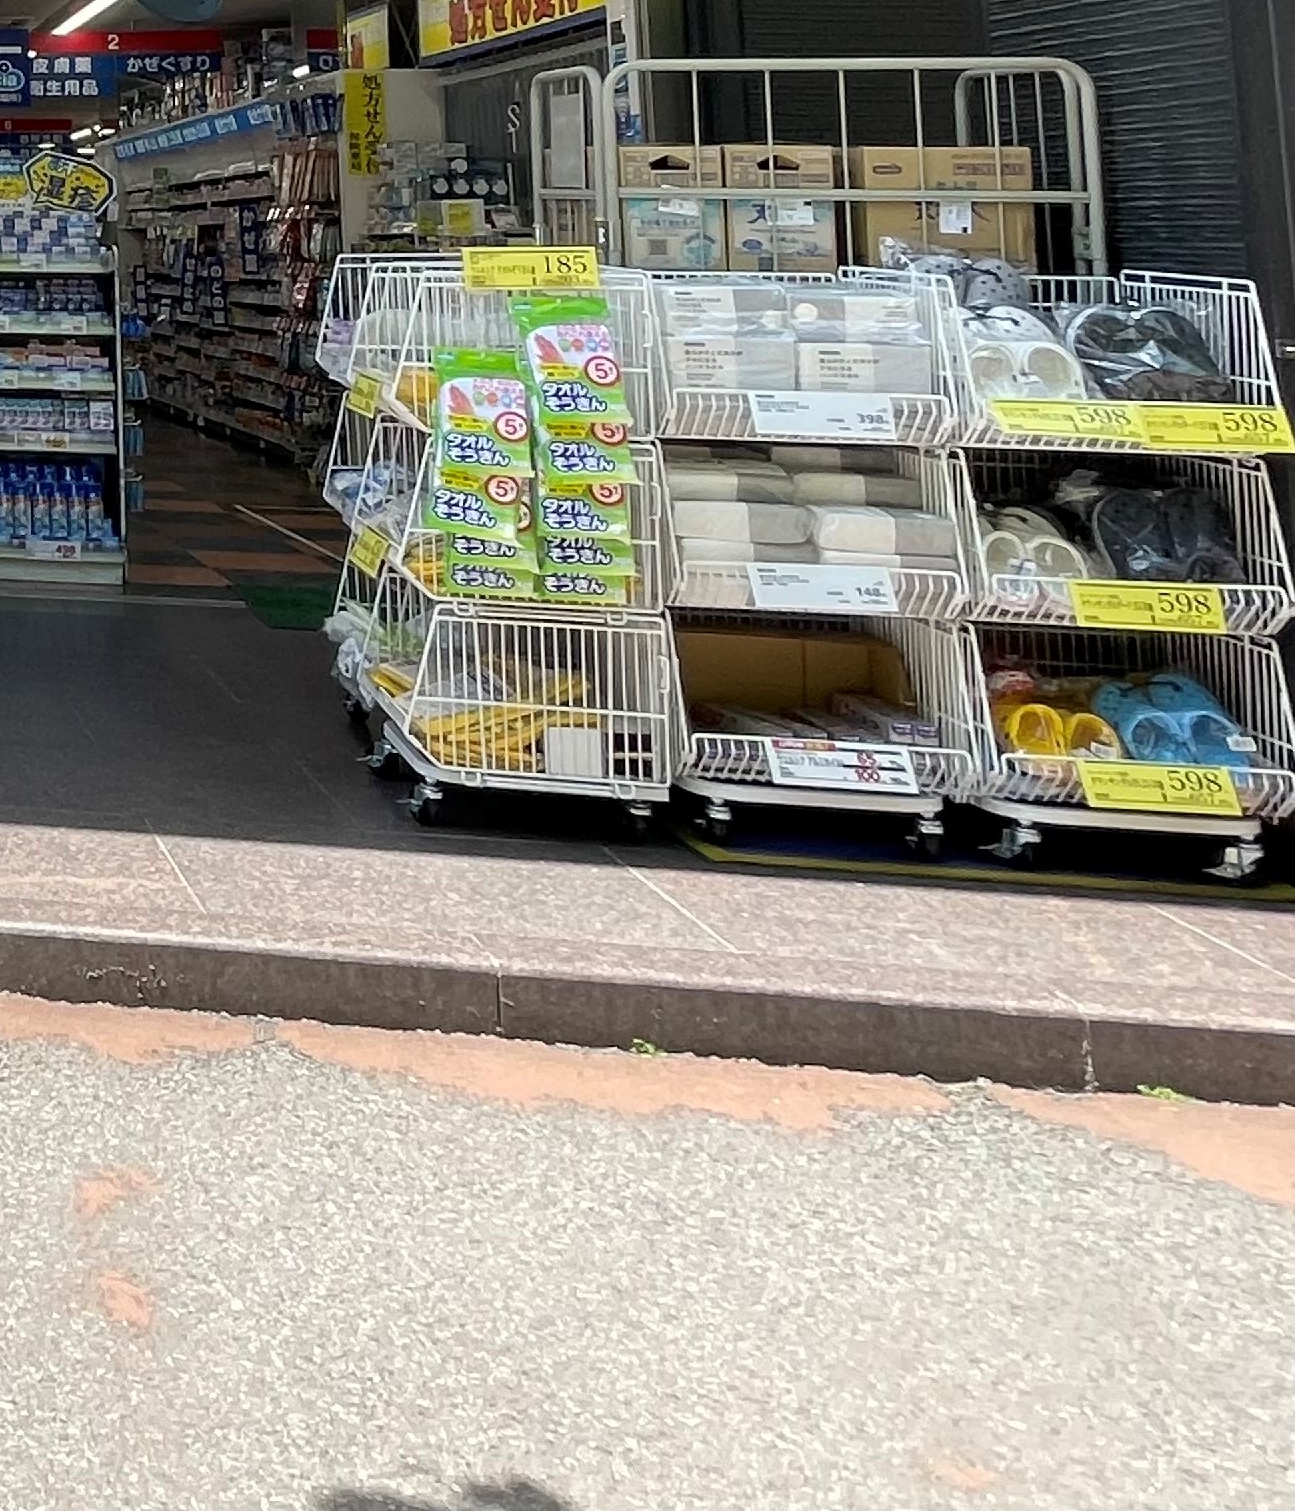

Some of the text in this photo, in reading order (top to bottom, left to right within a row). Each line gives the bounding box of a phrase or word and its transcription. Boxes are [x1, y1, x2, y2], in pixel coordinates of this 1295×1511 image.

[107, 34, 121, 51] 2
[544, 254, 588, 275] 185
[542, 381, 588, 396] タオル
[1072, 406, 1132, 427] 598
[1221, 411, 1279, 433] 598
[446, 433, 494, 450] タオル
[549, 442, 597, 457] タオル
[434, 490, 483, 509] タオル
[541, 498, 591, 514] タオル
[1157, 591, 1213, 615] 598
[1166, 769, 1224, 794] 598
